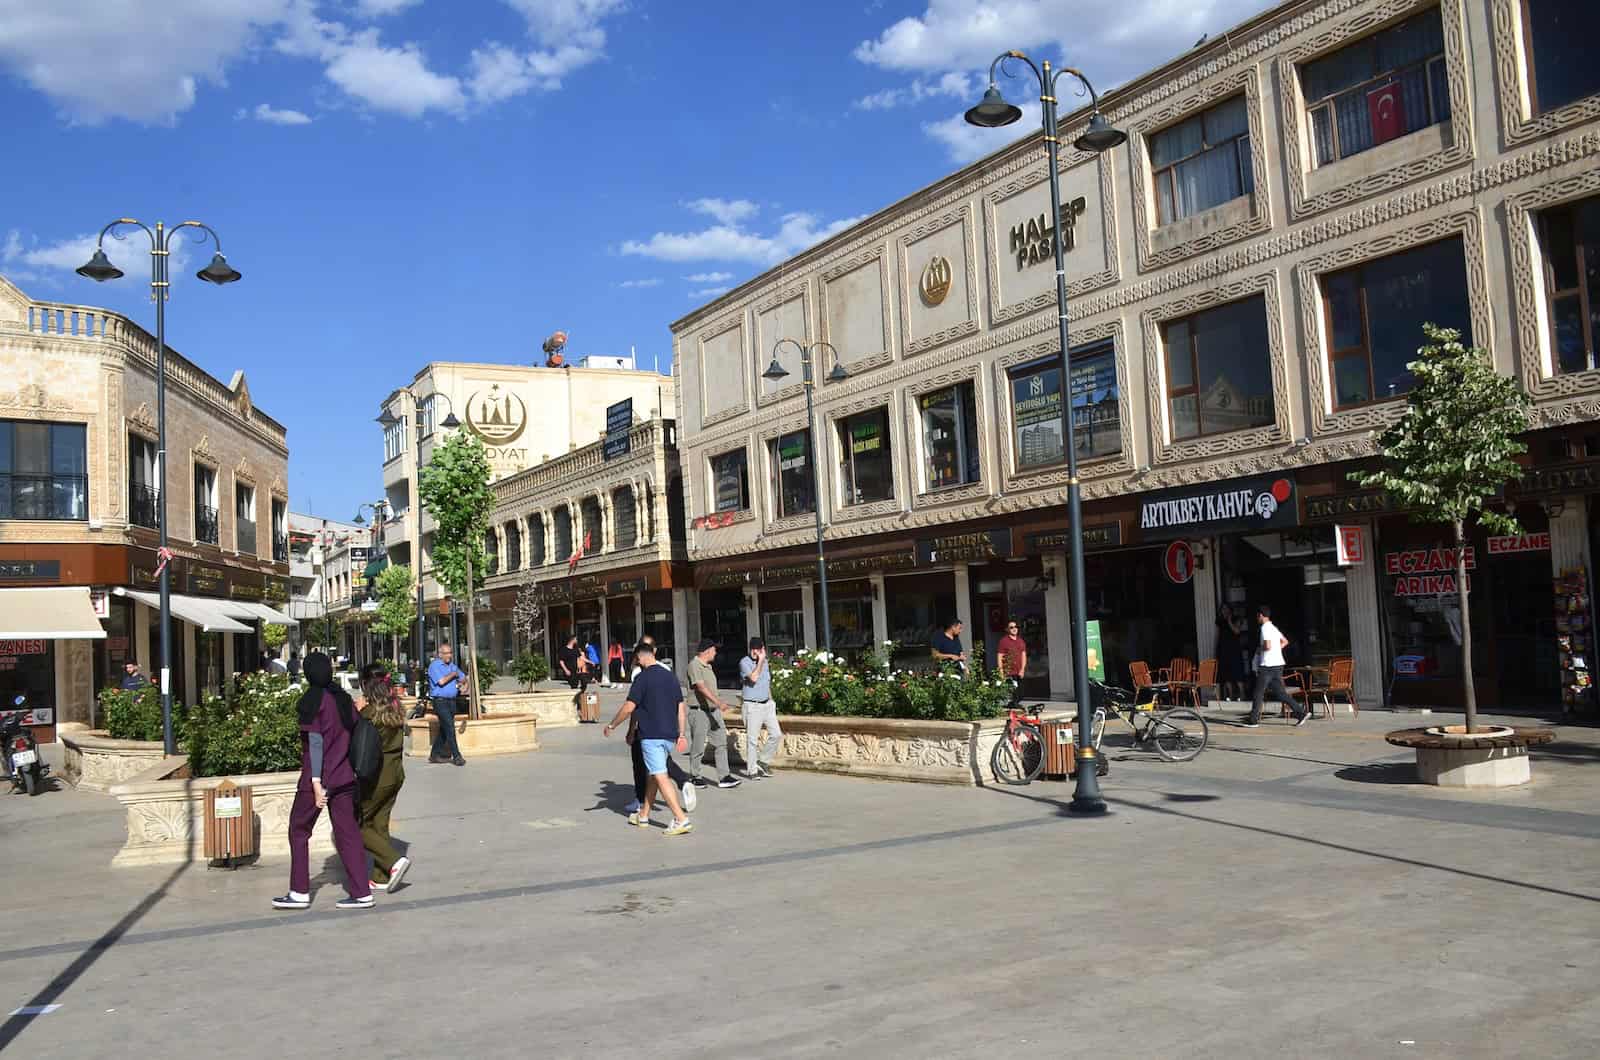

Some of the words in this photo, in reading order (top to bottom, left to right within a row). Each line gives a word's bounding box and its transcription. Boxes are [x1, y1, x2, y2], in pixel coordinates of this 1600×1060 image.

[1010, 196, 1087, 254] HALEP
[485, 447, 528, 460] DYAT
[1141, 496, 1206, 528] ARTUKBEY
[1205, 489, 1255, 521] KAHVE
[1311, 495, 1385, 516] ARIKAN
[1345, 531, 1357, 557] E
[1488, 534, 1550, 552] ECZANE
[1386, 546, 1475, 575] ECZANE
[0, 639, 47, 655] ZANESI
